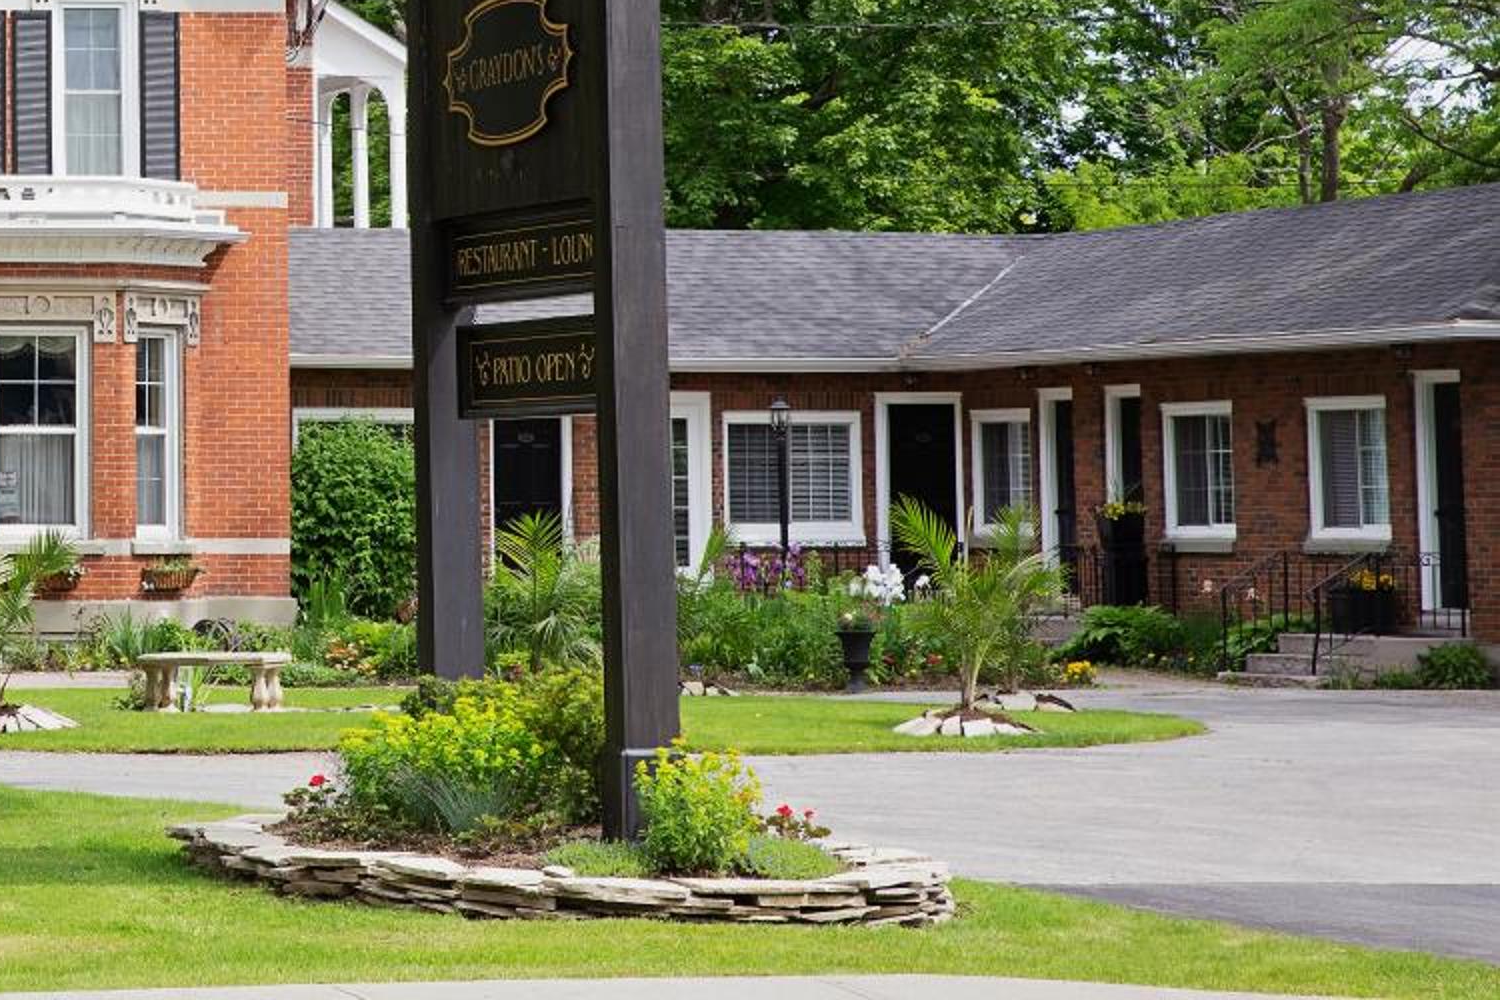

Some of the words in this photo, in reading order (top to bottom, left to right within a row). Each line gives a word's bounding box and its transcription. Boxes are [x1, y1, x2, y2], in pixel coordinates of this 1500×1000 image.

[457, 239, 537, 276] RESTAURANT
[552, 232, 594, 265] LOUN
[493, 355, 531, 385] PATIO
[535, 352, 575, 382] OPEN
